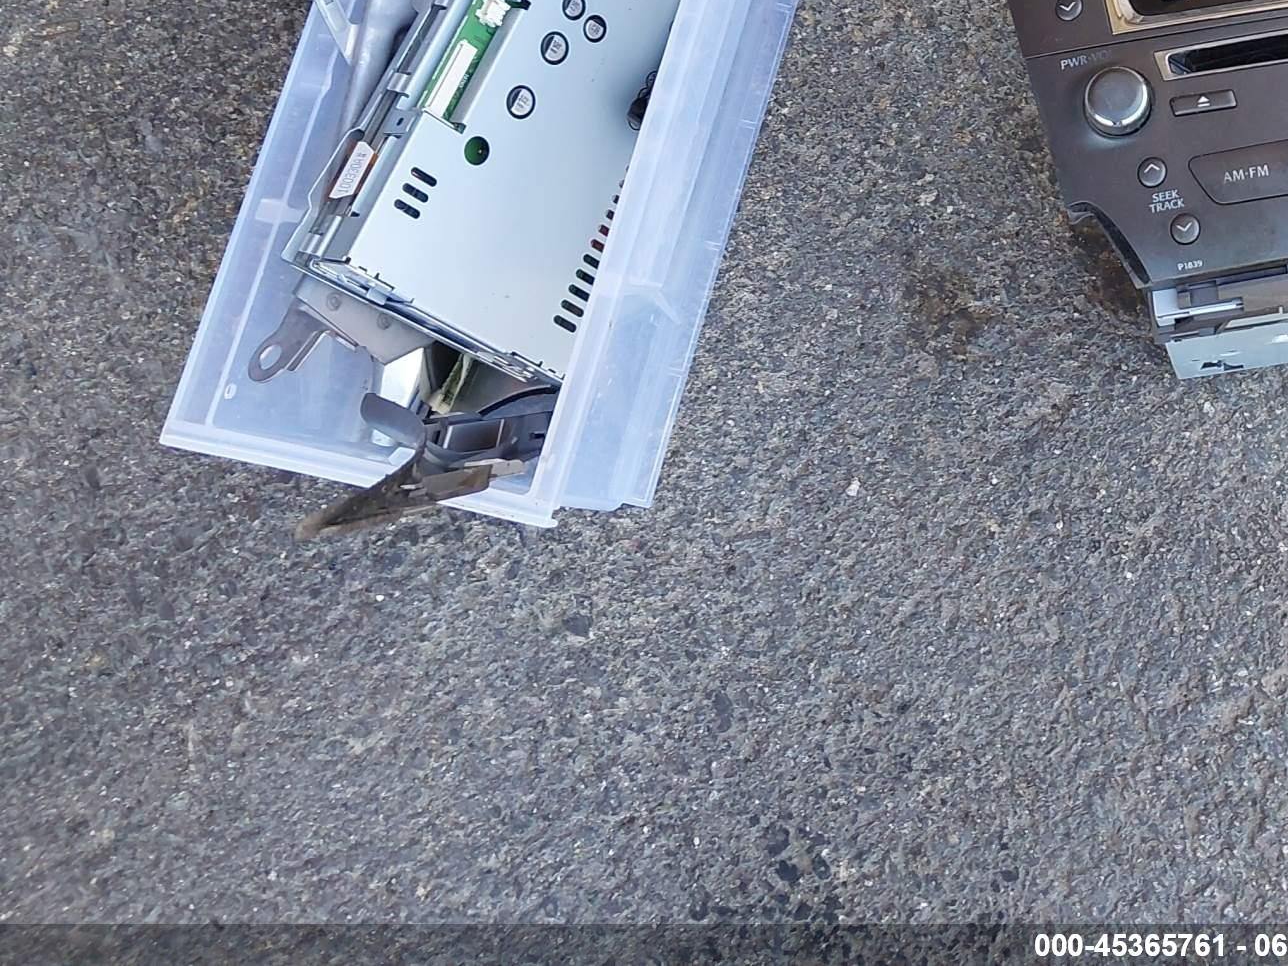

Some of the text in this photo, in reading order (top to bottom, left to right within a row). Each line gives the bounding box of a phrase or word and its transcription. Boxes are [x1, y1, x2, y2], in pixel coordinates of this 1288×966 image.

[1152, 189, 1180, 203] SEEK
[1149, 198, 1185, 214] TRACK
[1177, 259, 1203, 271] P1839
